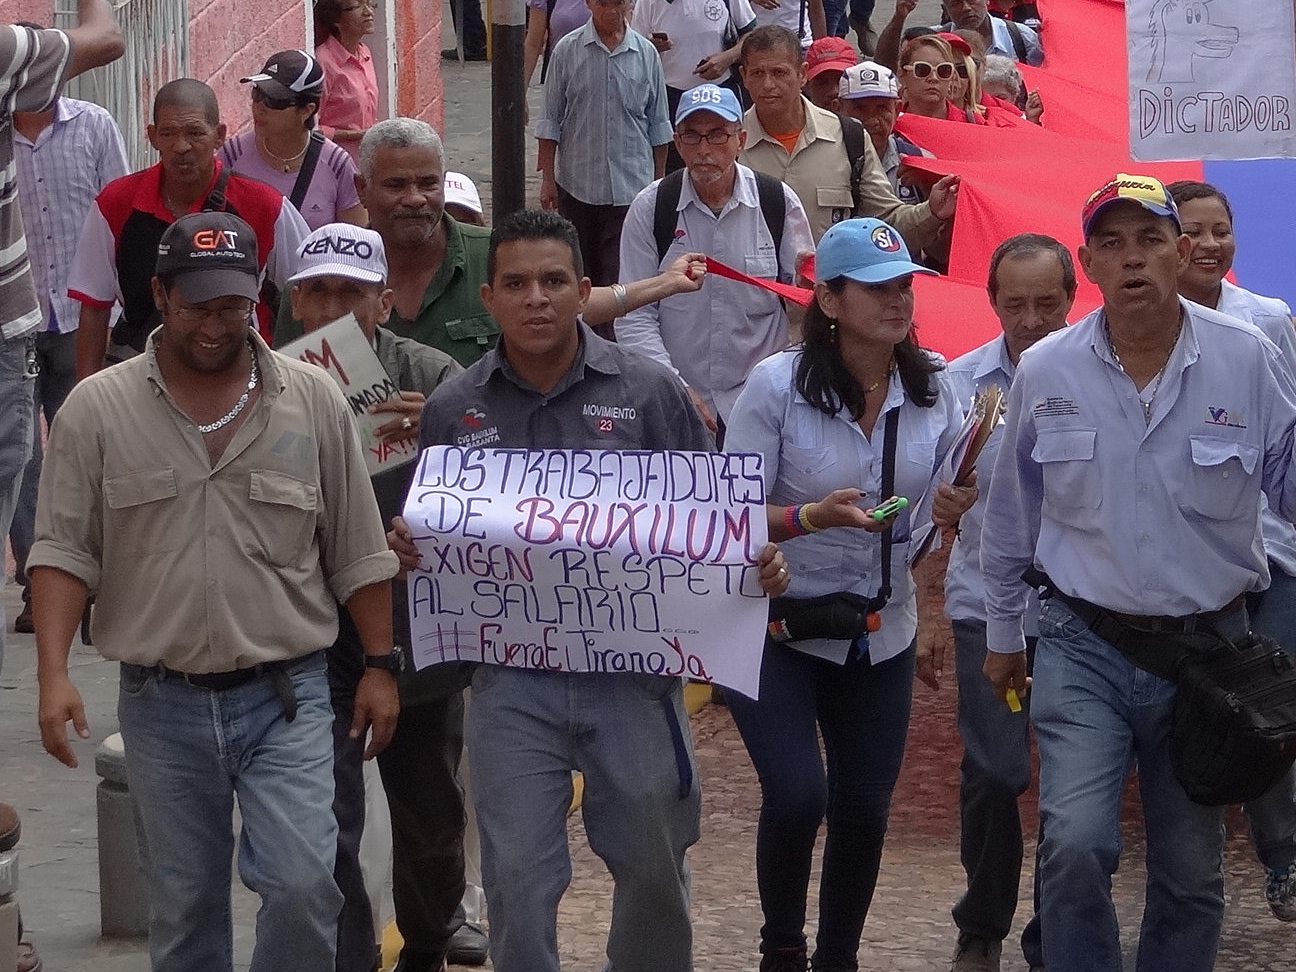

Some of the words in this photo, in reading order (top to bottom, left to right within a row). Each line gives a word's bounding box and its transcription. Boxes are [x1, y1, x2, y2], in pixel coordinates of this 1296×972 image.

[691, 90, 721, 104] 905
[194, 230, 238, 249] GAT
[301, 236, 373, 259] KENZO
[583, 404, 636, 419] MOVIMIENTO
[599, 420, 612, 431] 23
[457, 432, 470, 444] CVG
[418, 447, 486, 491] LOS
[418, 492, 491, 538] DE
[514, 498, 756, 563] BAUXILUM
[550, 549, 768, 598] RESPETO
[414, 576, 463, 619] AL
